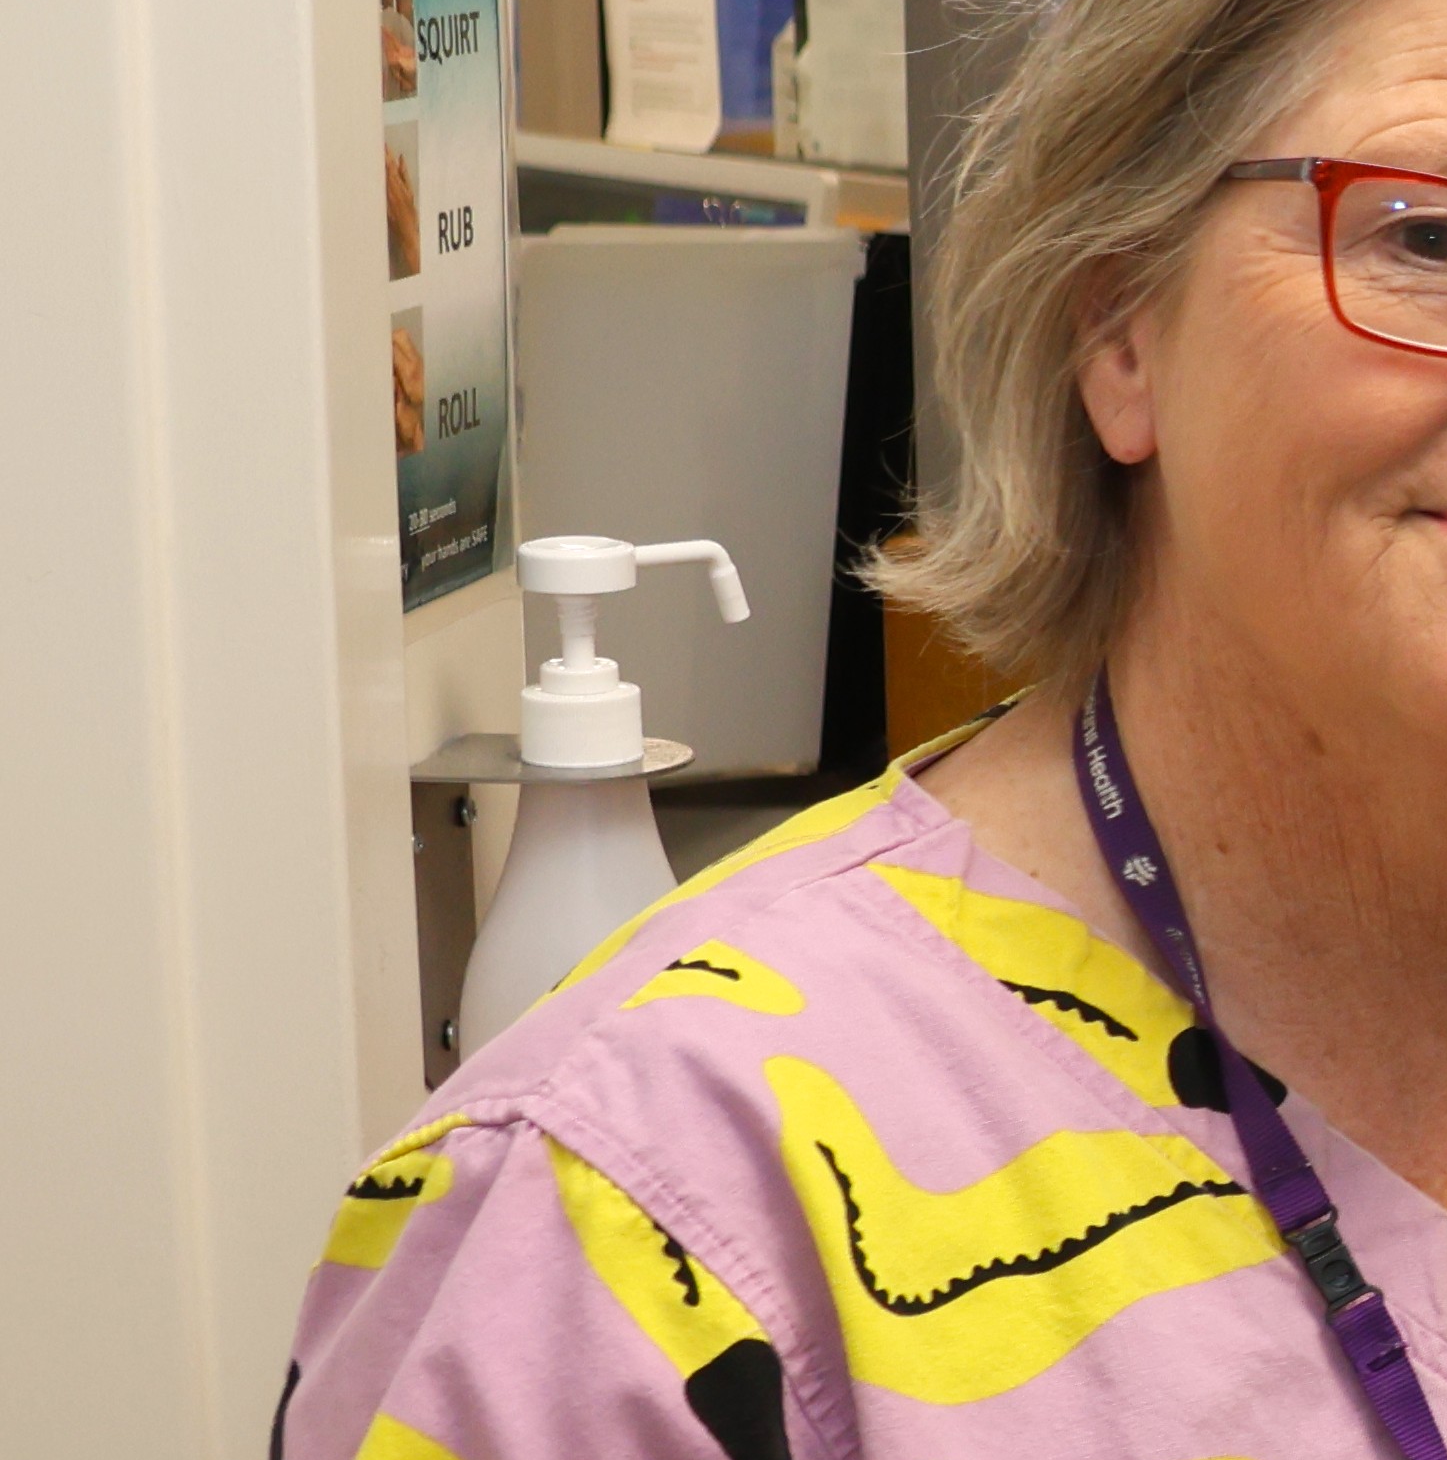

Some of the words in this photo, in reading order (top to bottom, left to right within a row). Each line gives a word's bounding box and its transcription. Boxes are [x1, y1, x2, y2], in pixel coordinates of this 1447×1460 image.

[417, 11, 480, 66] SQUIRT
[437, 205, 475, 255] RUB
[438, 387, 481, 439] ROLL
[1086, 744, 1124, 821] Health
